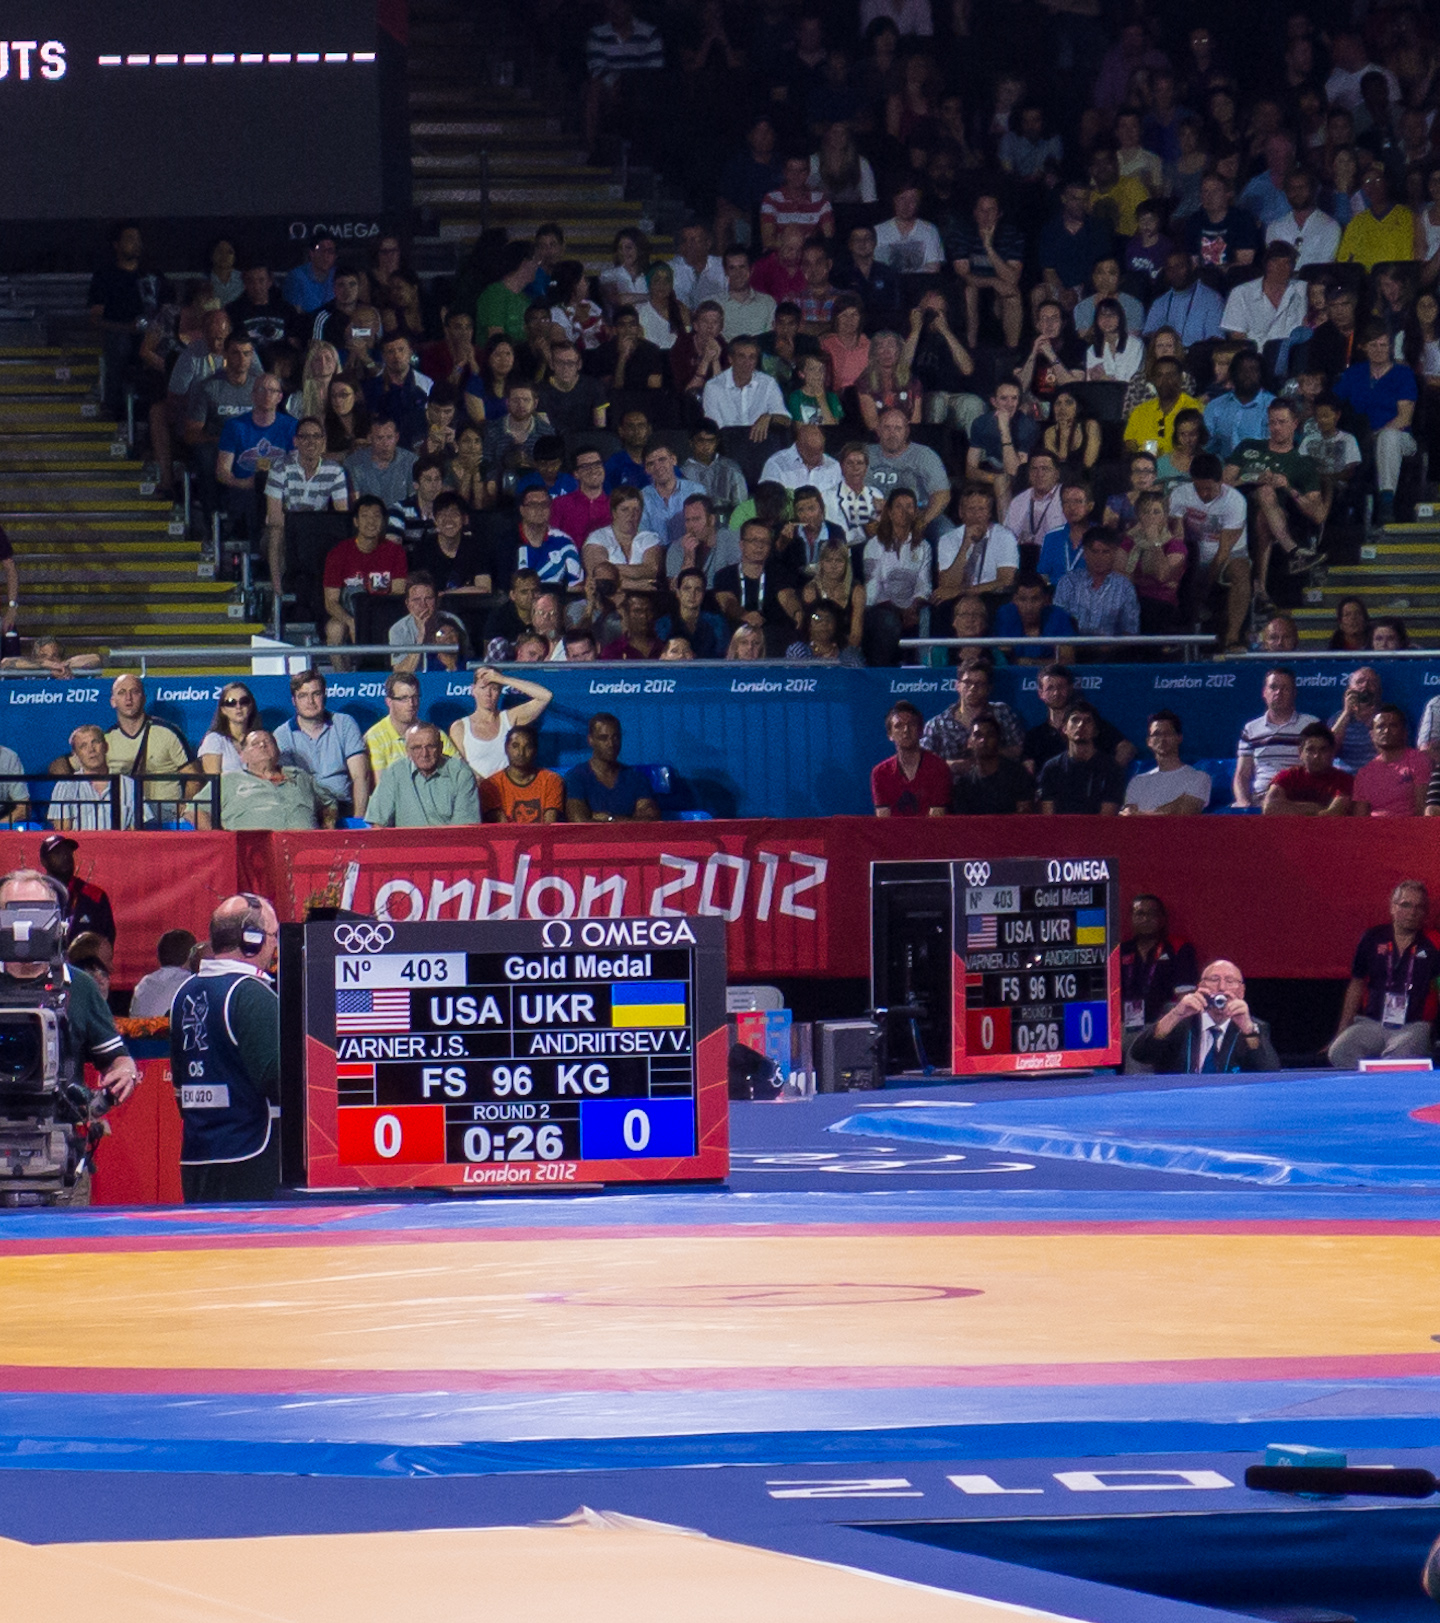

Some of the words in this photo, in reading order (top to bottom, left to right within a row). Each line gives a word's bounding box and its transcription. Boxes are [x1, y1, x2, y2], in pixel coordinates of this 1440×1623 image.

[589, 679, 641, 694] London
[644, 678, 677, 693] 2012
[731, 678, 780, 693] London
[783, 677, 817, 692] 2012
[890, 678, 938, 693] London
[1154, 675, 1202, 689] London
[1205, 674, 1237, 688] 2012
[1295, 673, 1337, 687] ondon
[10, 690, 62, 705] London
[66, 689, 99, 703] 2012
[157, 687, 210, 702] London
[1063, 860, 1110, 881] OMEGA
[339, 854, 628, 921] London
[650, 851, 828, 922] 2012
[1035, 889, 1059, 907] Gold
[1062, 887, 1093, 906] Medal
[582, 919, 696, 948] OMEGA
[1005, 922, 1034, 944] USA
[1040, 919, 1071, 942] UKR
[343, 960, 372, 983] Nº
[401, 958, 448, 981] 403
[505, 955, 567, 981] Gold
[575, 953, 651, 978] Medal
[1001, 977, 1020, 1002] FS
[1029, 975, 1046, 1000] 96
[1055, 974, 1077, 998] KG
[430, 996, 503, 1026] USA
[520, 995, 596, 1024] UKR
[981, 1015, 994, 1050] 0
[1017, 1023, 1060, 1052] 0:26
[1080, 1009, 1093, 1044] 0
[431, 1037, 469, 1058] J.S.
[530, 1031, 665, 1054] ANDRIITSEV
[669, 1030, 691, 1052] V.
[422, 1067, 467, 1098] FS
[493, 1066, 533, 1096] 96
[557, 1064, 610, 1095] KG
[473, 1105, 534, 1121] ROUND
[539, 1104, 550, 1120] 2
[373, 1114, 402, 1159] 0
[623, 1108, 651, 1152] 0
[463, 1124, 564, 1162] 0:26
[463, 1165, 531, 1184] London
[535, 1164, 577, 1181] 2012
